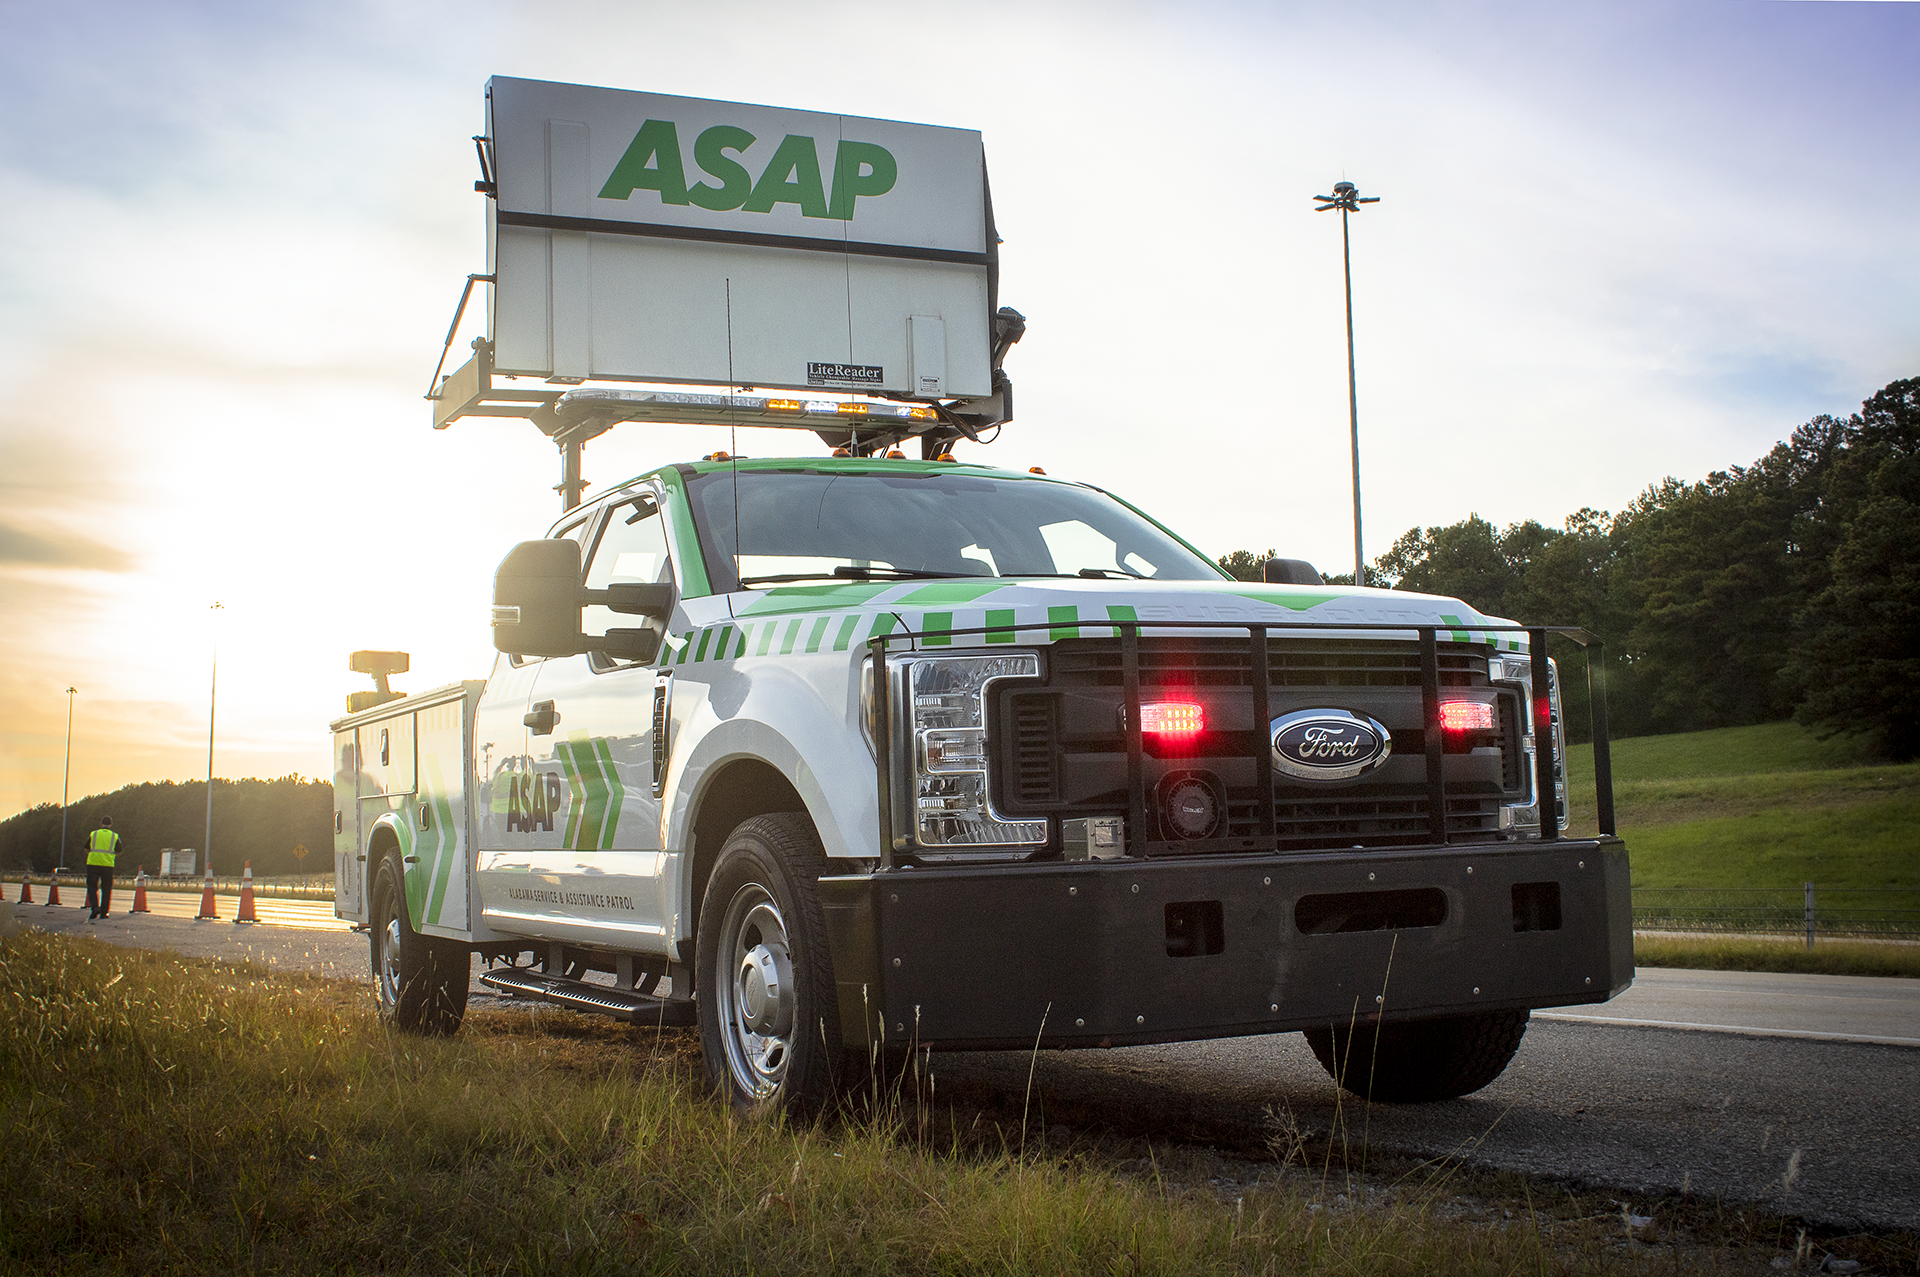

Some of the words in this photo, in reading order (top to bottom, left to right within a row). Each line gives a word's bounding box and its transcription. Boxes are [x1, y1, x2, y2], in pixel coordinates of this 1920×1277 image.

[597, 119, 897, 221] ASAP
[809, 363, 880, 378] LiteReader
[1299, 727, 1360, 758] Ford
[507, 772, 561, 833] ASAP
[509, 888, 534, 901] ALABAMA
[534, 890, 558, 903] SERVICE
[559, 892, 564, 904] &
[566, 893, 605, 908] ASSISTANCE
[606, 895, 635, 910] PATROL
